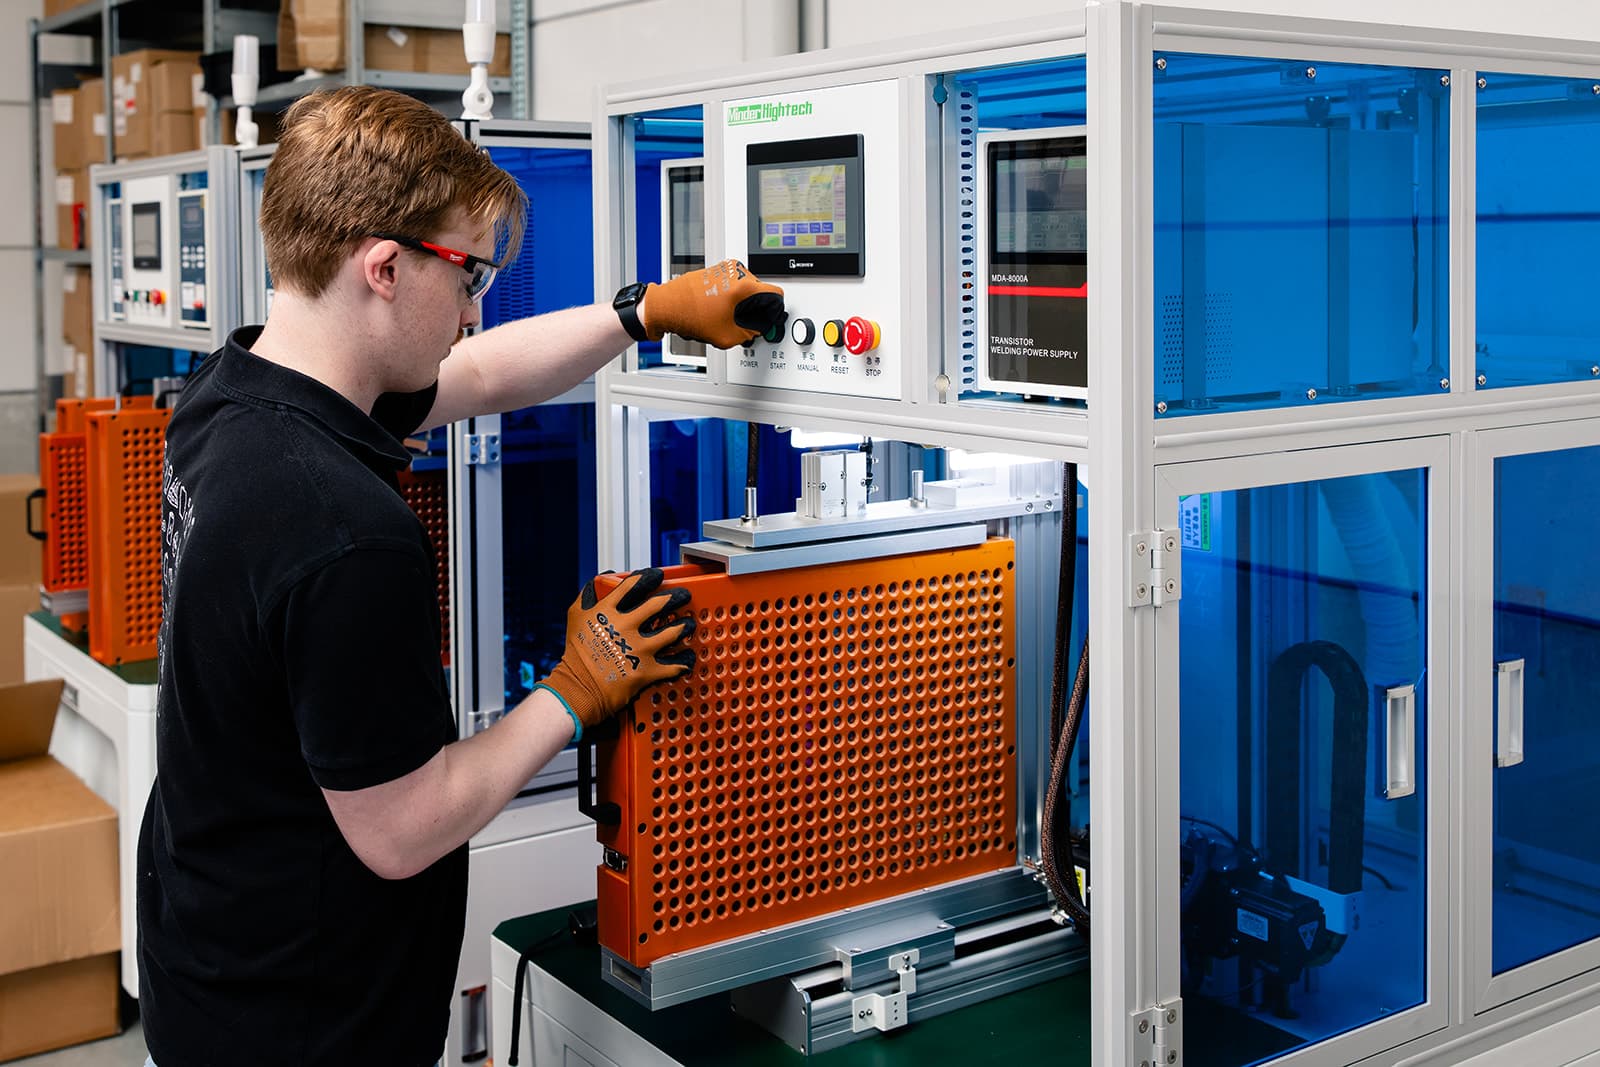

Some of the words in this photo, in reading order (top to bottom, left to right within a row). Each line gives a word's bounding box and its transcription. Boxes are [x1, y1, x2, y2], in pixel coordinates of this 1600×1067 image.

[991, 274, 1029, 282] MDA-8000A
[990, 336, 1034, 346] TRANSISTOR
[990, 346, 1022, 355] WELDING
[1022, 348, 1049, 357] POWER
[1049, 349, 1079, 359] SUPPLY
[740, 360, 759, 369] POWER
[769, 362, 787, 370] START
[797, 364, 819, 372] MANUAL
[831, 366, 849, 374] RESET
[865, 368, 882, 377] STOP
[596, 612, 641, 671] OXXA
